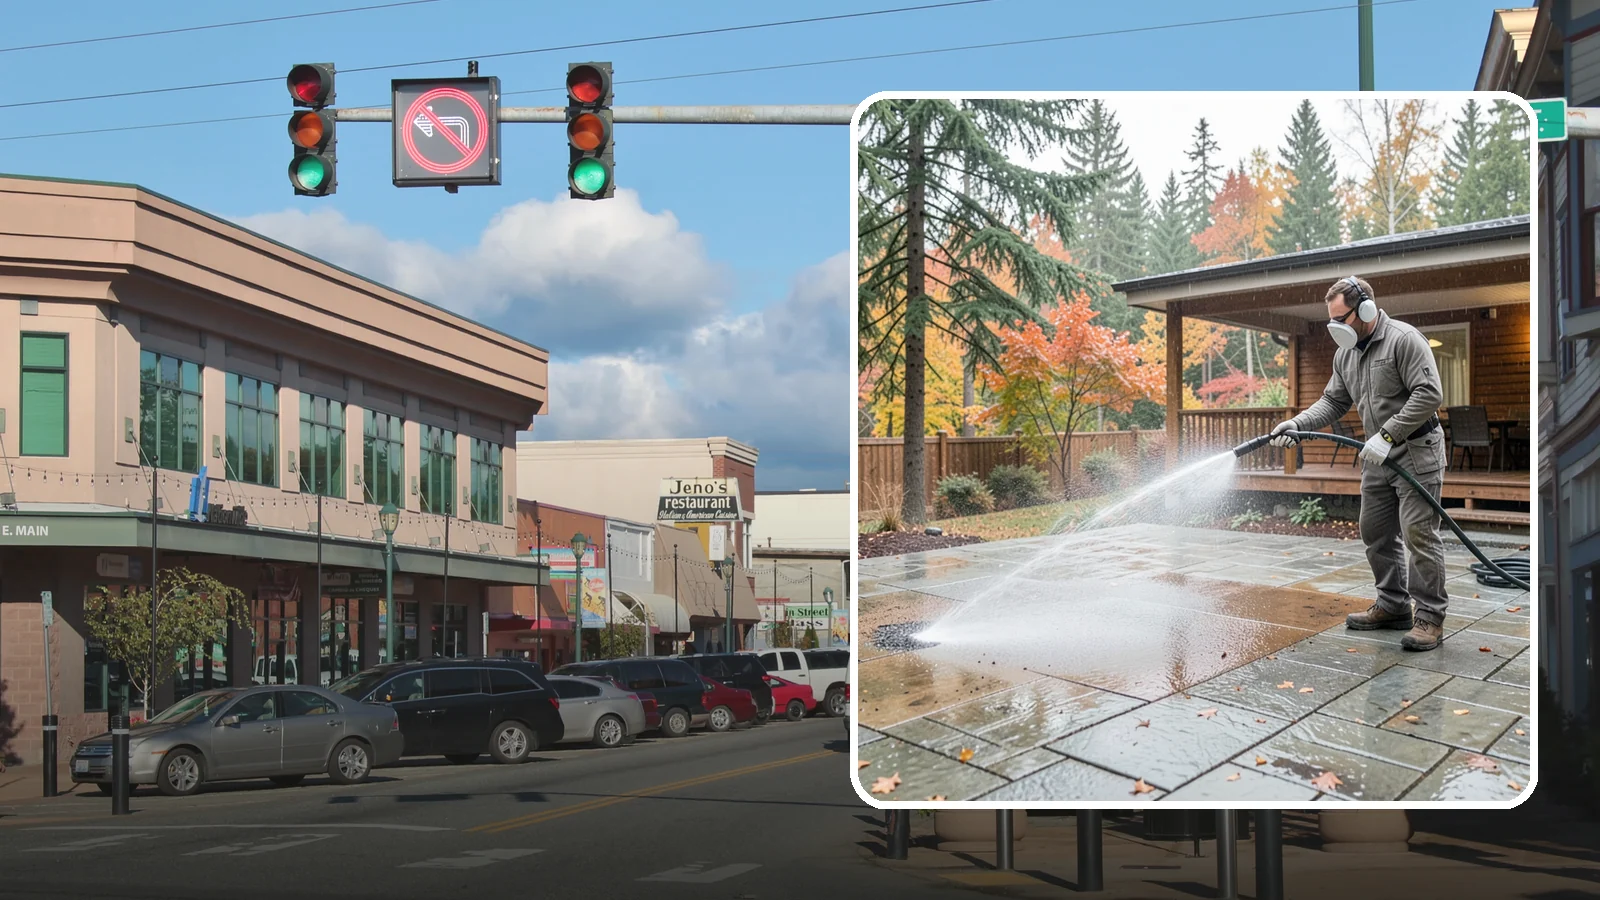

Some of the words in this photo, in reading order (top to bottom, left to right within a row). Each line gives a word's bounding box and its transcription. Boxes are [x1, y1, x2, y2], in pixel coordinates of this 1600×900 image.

[669, 480, 727, 495] Jeno's
[664, 496, 731, 509] restaurant
[658, 510, 681, 519] Italian
[686, 509, 714, 519] American
[715, 509, 737, 519] Cuisine
[2, 525, 13, 536] E.
[15, 525, 49, 536] MAIN
[797, 607, 828, 616] Street
